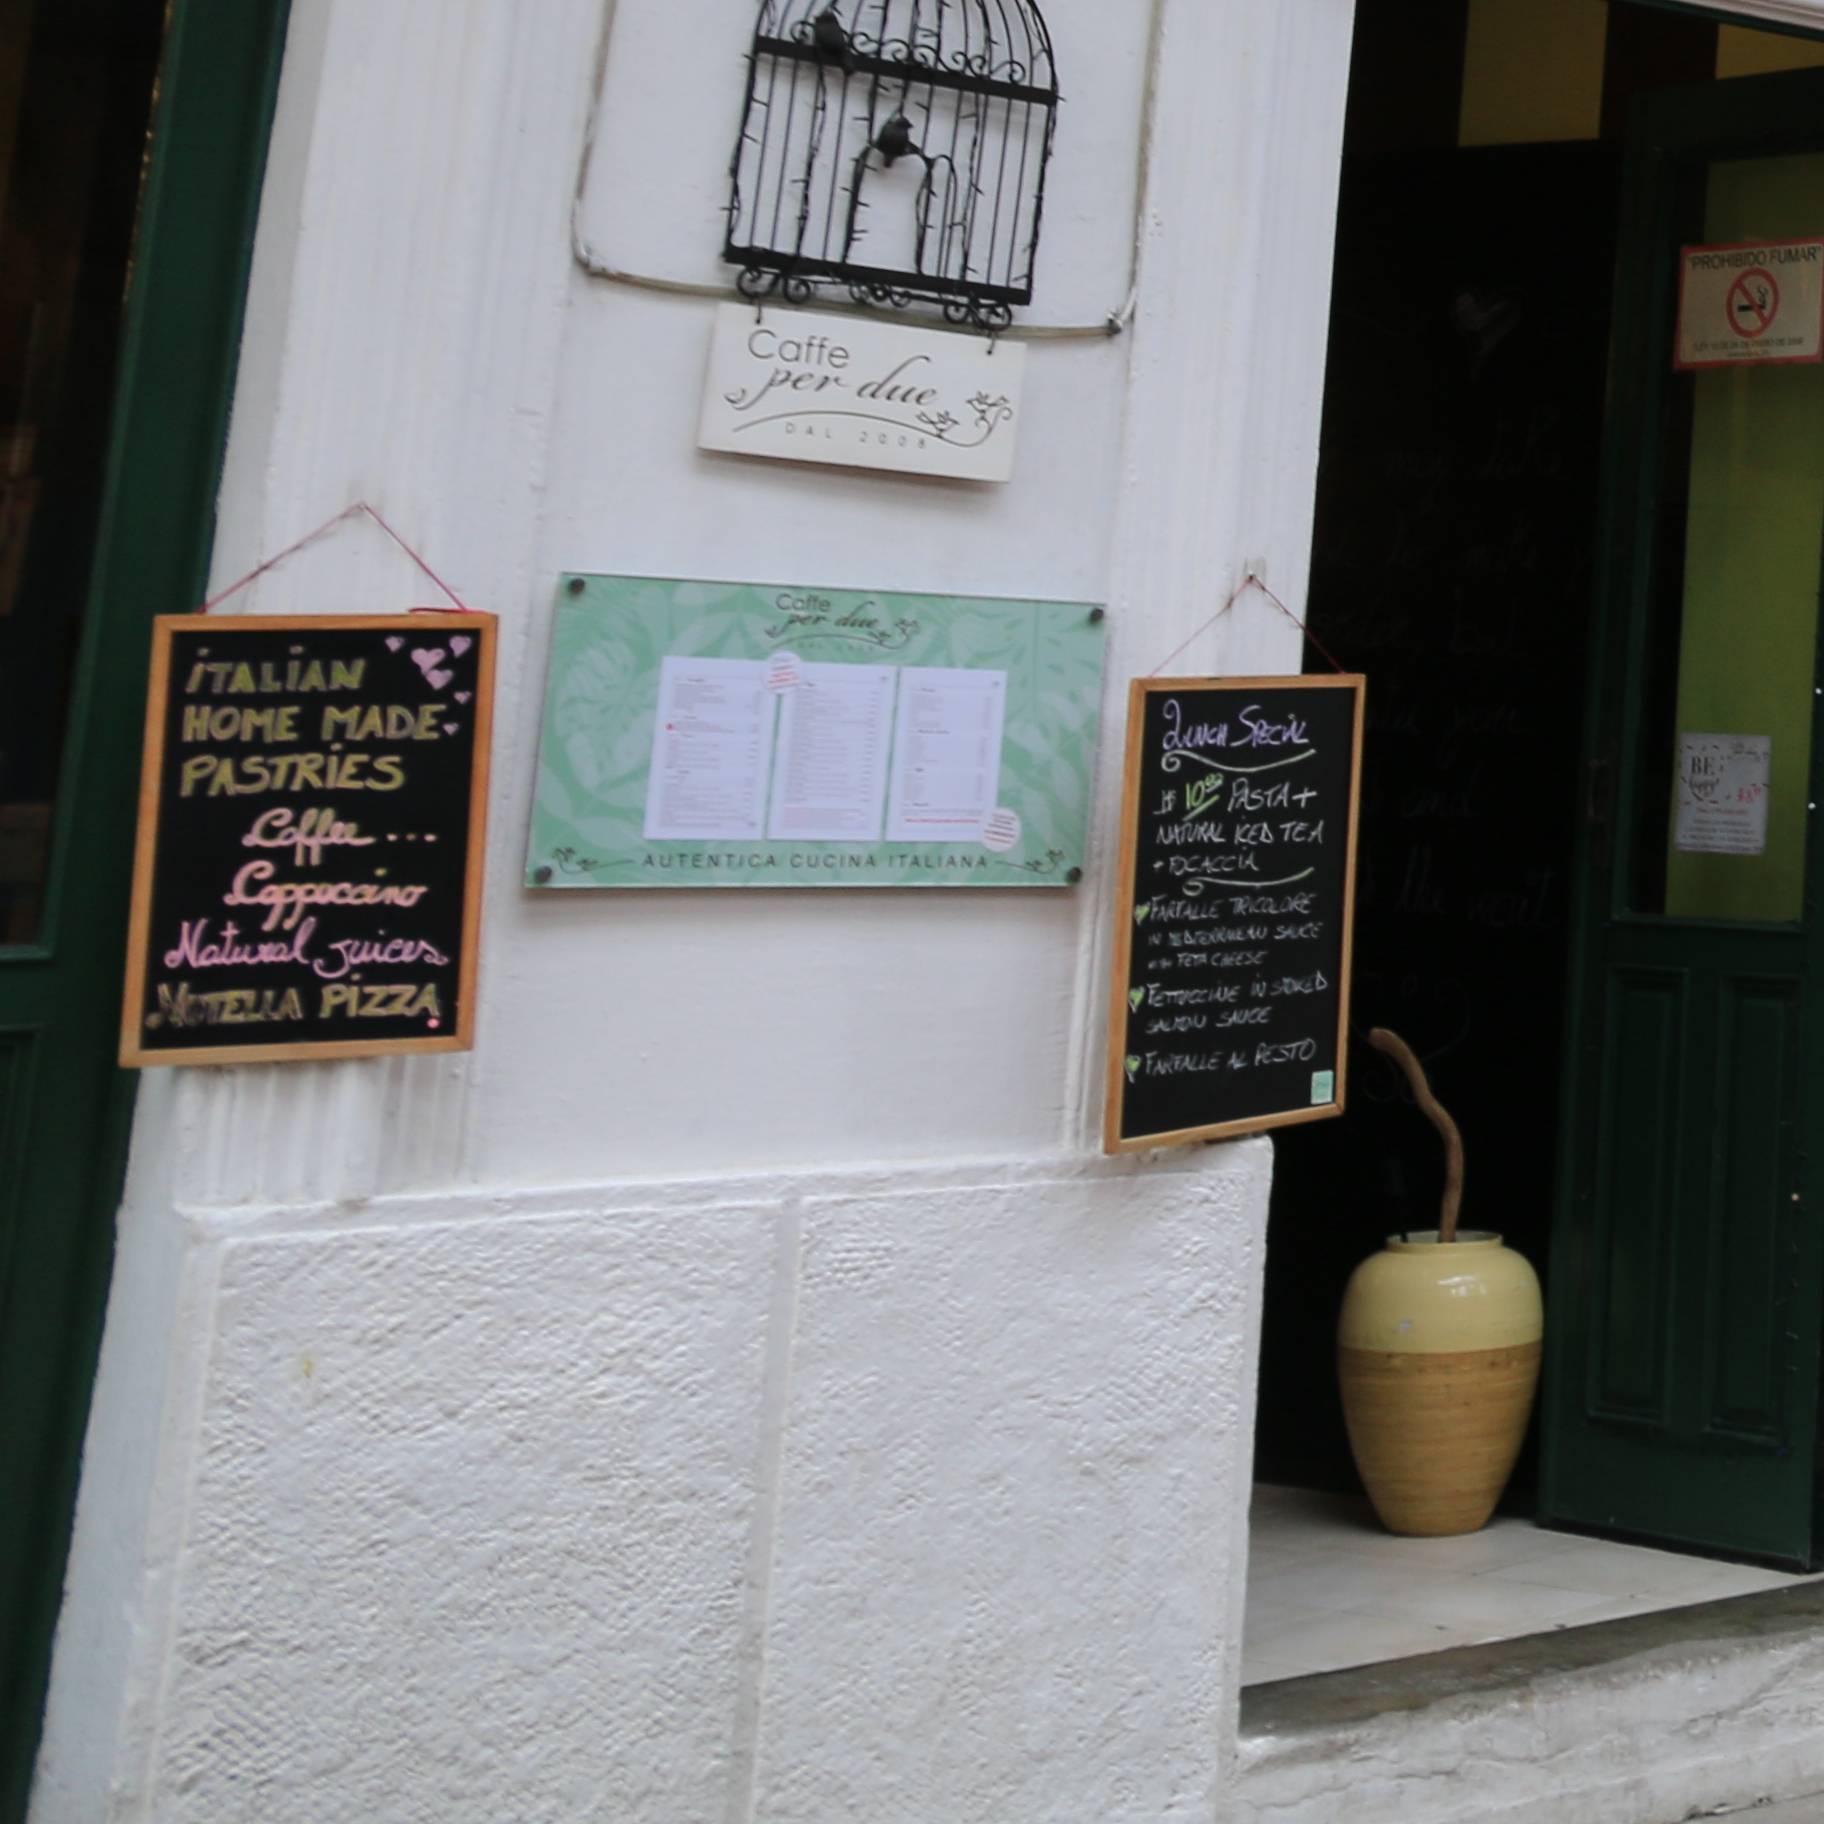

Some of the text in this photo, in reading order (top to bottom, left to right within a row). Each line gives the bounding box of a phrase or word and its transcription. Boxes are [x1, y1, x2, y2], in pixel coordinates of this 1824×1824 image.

[748, 328, 850, 369] Caffe
[738, 354, 939, 410] per due
[776, 592, 831, 613] Caffe
[777, 600, 880, 638] per due
[181, 703, 447, 744] HOME MADE
[1227, 776, 1291, 813] PASTA
[241, 807, 376, 867] Coffee
[1156, 821, 1226, 845] NATURAL
[1279, 821, 1325, 845] TEA
[641, 852, 989, 869] AUTENTICA CUCINA ITALIANA
[1149, 891, 1317, 923] FARFALLE TRICOLORE
[164, 916, 314, 969] Natural
[1145, 1049, 1224, 1075] FARFALLE
[1254, 1037, 1317, 1067] PESTO
